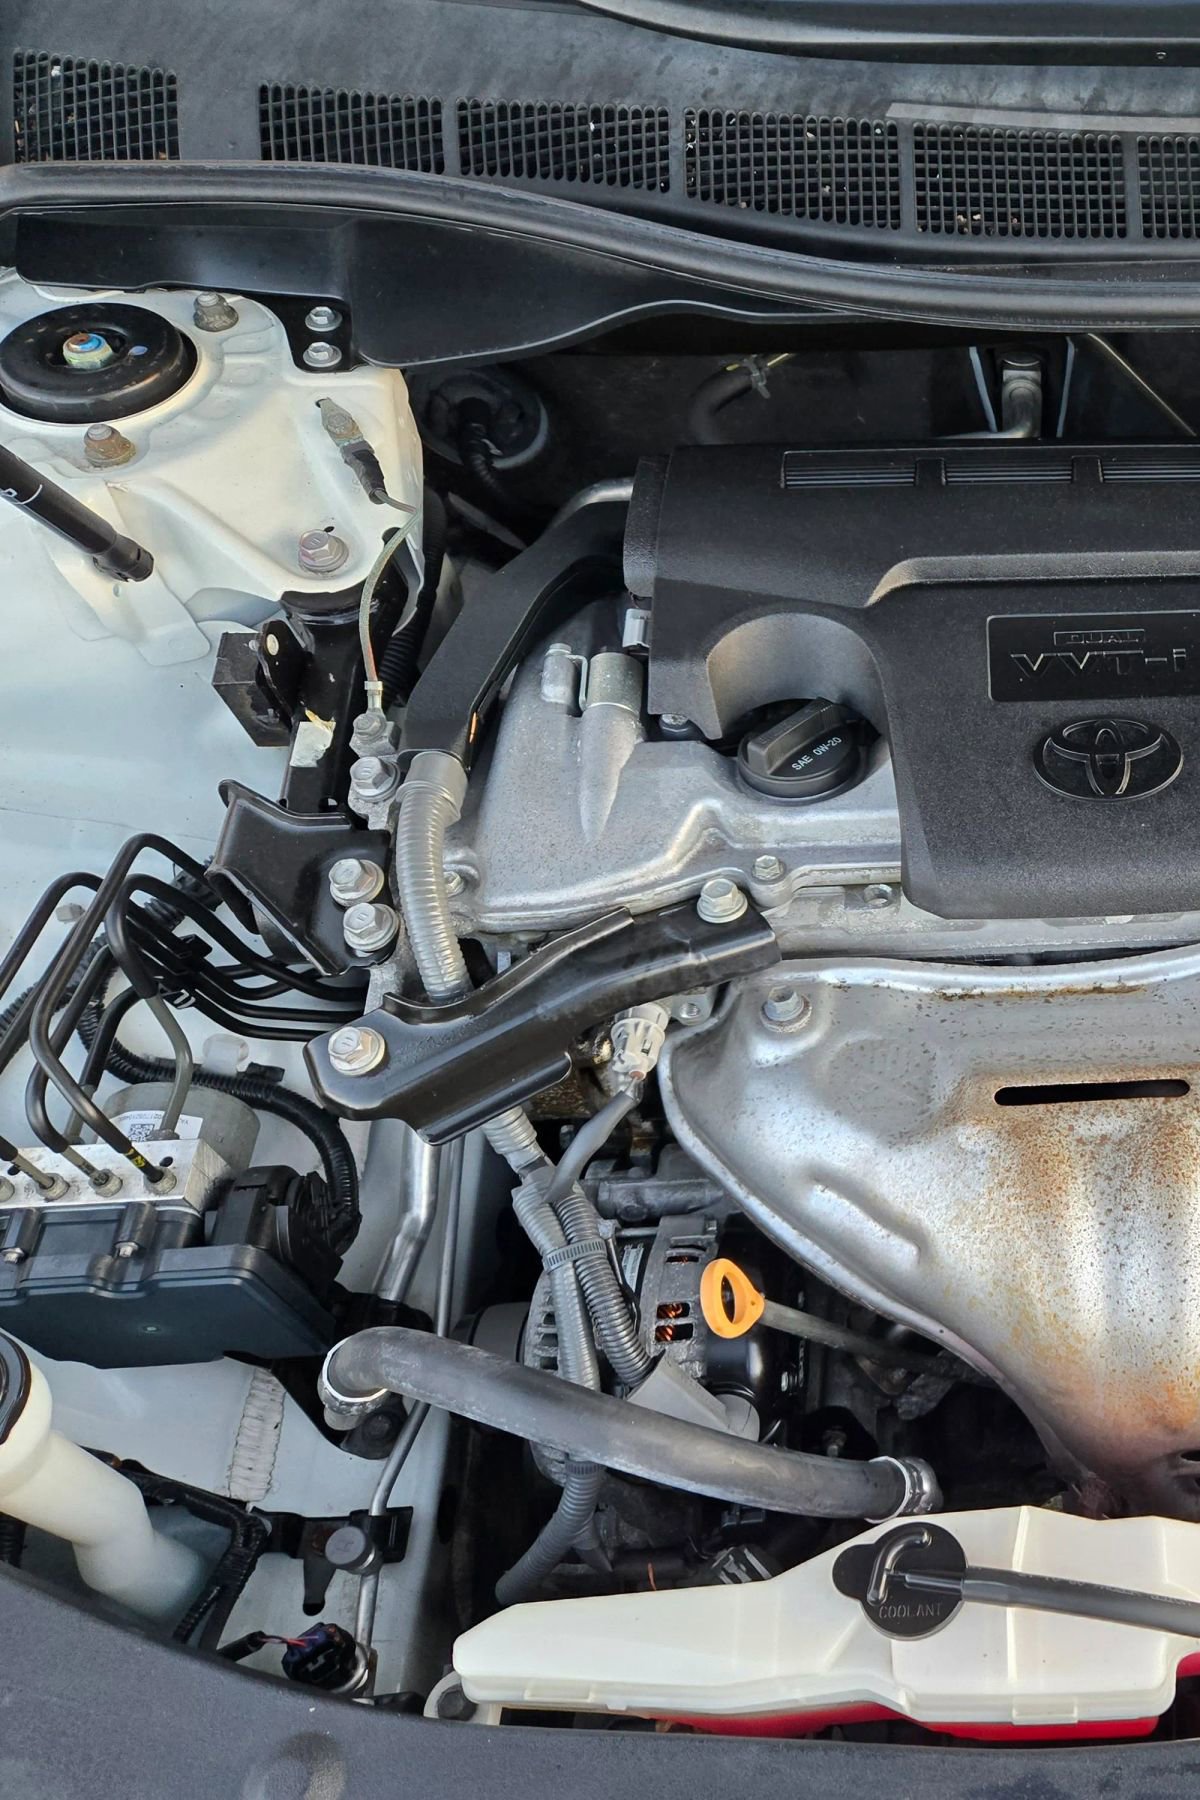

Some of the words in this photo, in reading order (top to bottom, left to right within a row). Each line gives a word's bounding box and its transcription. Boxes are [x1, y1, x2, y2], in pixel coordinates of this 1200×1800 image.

[791, 754, 814, 771] SAE
[812, 736, 843, 756] 0W-20
[879, 1603, 943, 1619] COOLANT
